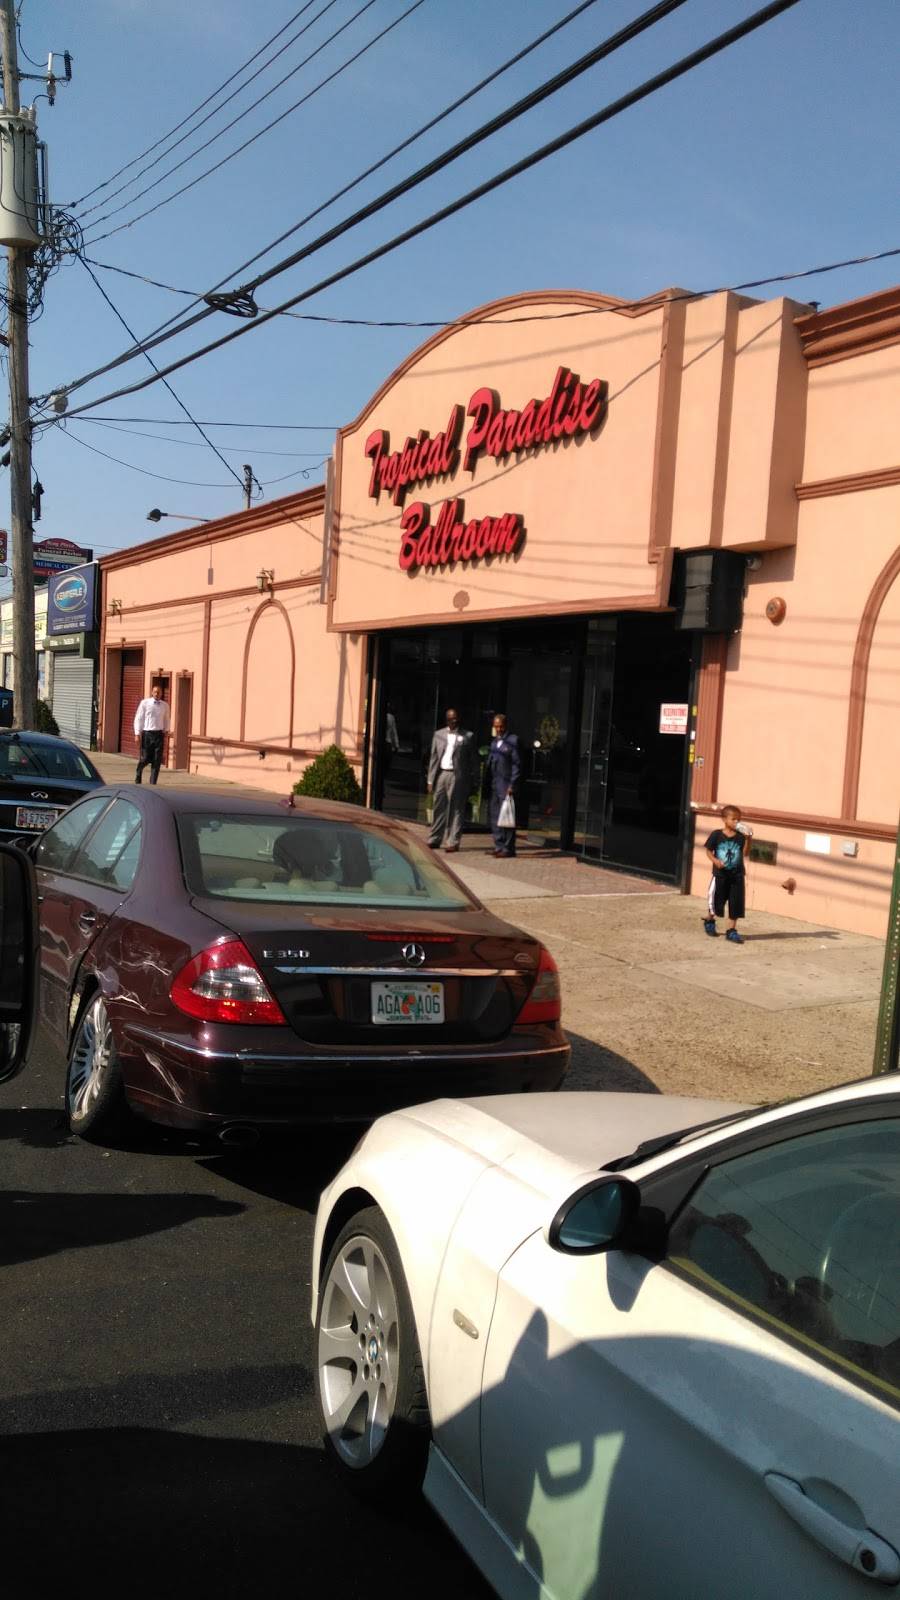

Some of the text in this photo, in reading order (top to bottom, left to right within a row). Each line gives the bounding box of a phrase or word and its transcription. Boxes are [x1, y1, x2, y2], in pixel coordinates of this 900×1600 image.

[365, 366, 608, 506] Tropical Paradise
[399, 498, 527, 570] Ballroom
